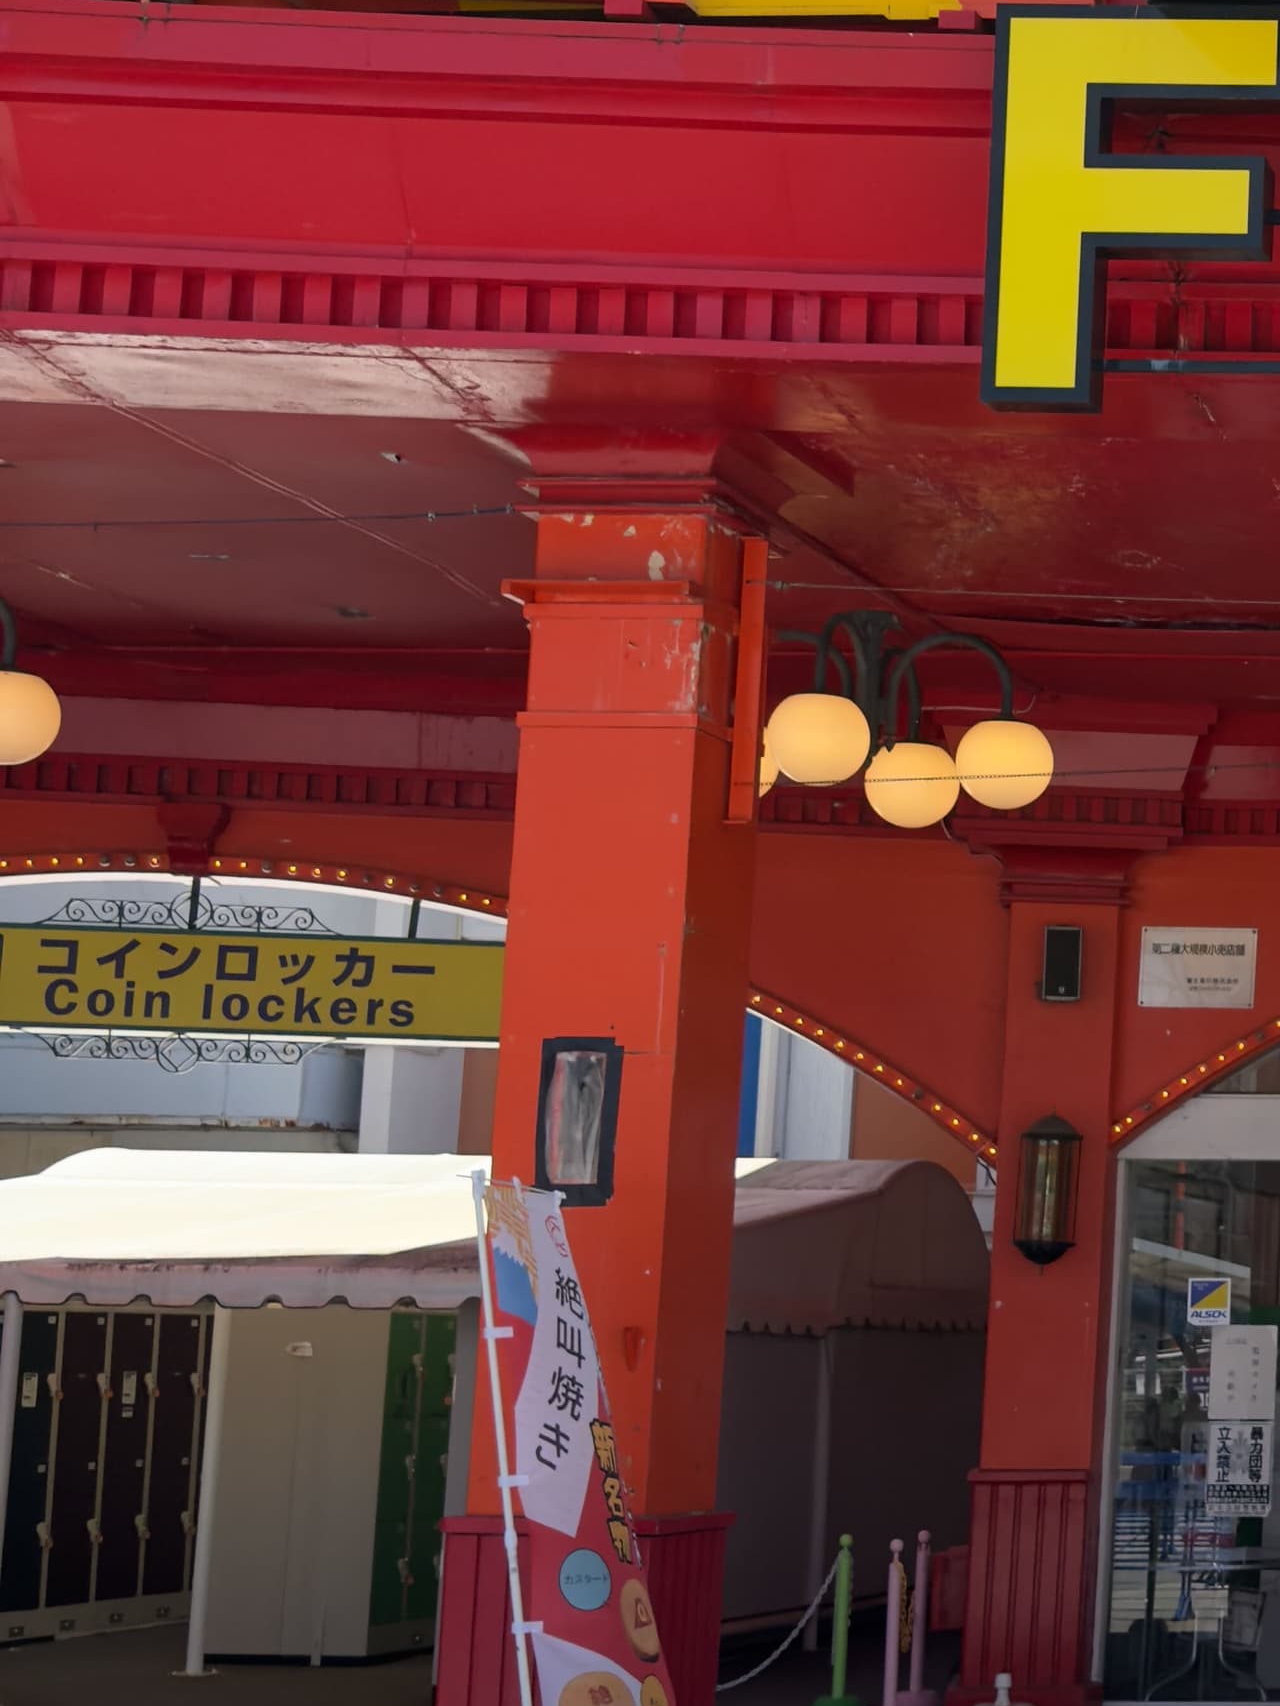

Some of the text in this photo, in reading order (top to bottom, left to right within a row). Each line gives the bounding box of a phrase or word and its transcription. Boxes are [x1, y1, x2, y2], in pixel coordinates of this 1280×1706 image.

[37, 938, 436, 987] コインロッカー
[44, 979, 416, 1028] Coin lockers
[536, 1267, 586, 1471] 絶叫焼き
[1216, 1426, 1232, 1483] 立入禁止
[1249, 1427, 1264, 1483] 暴力団等
